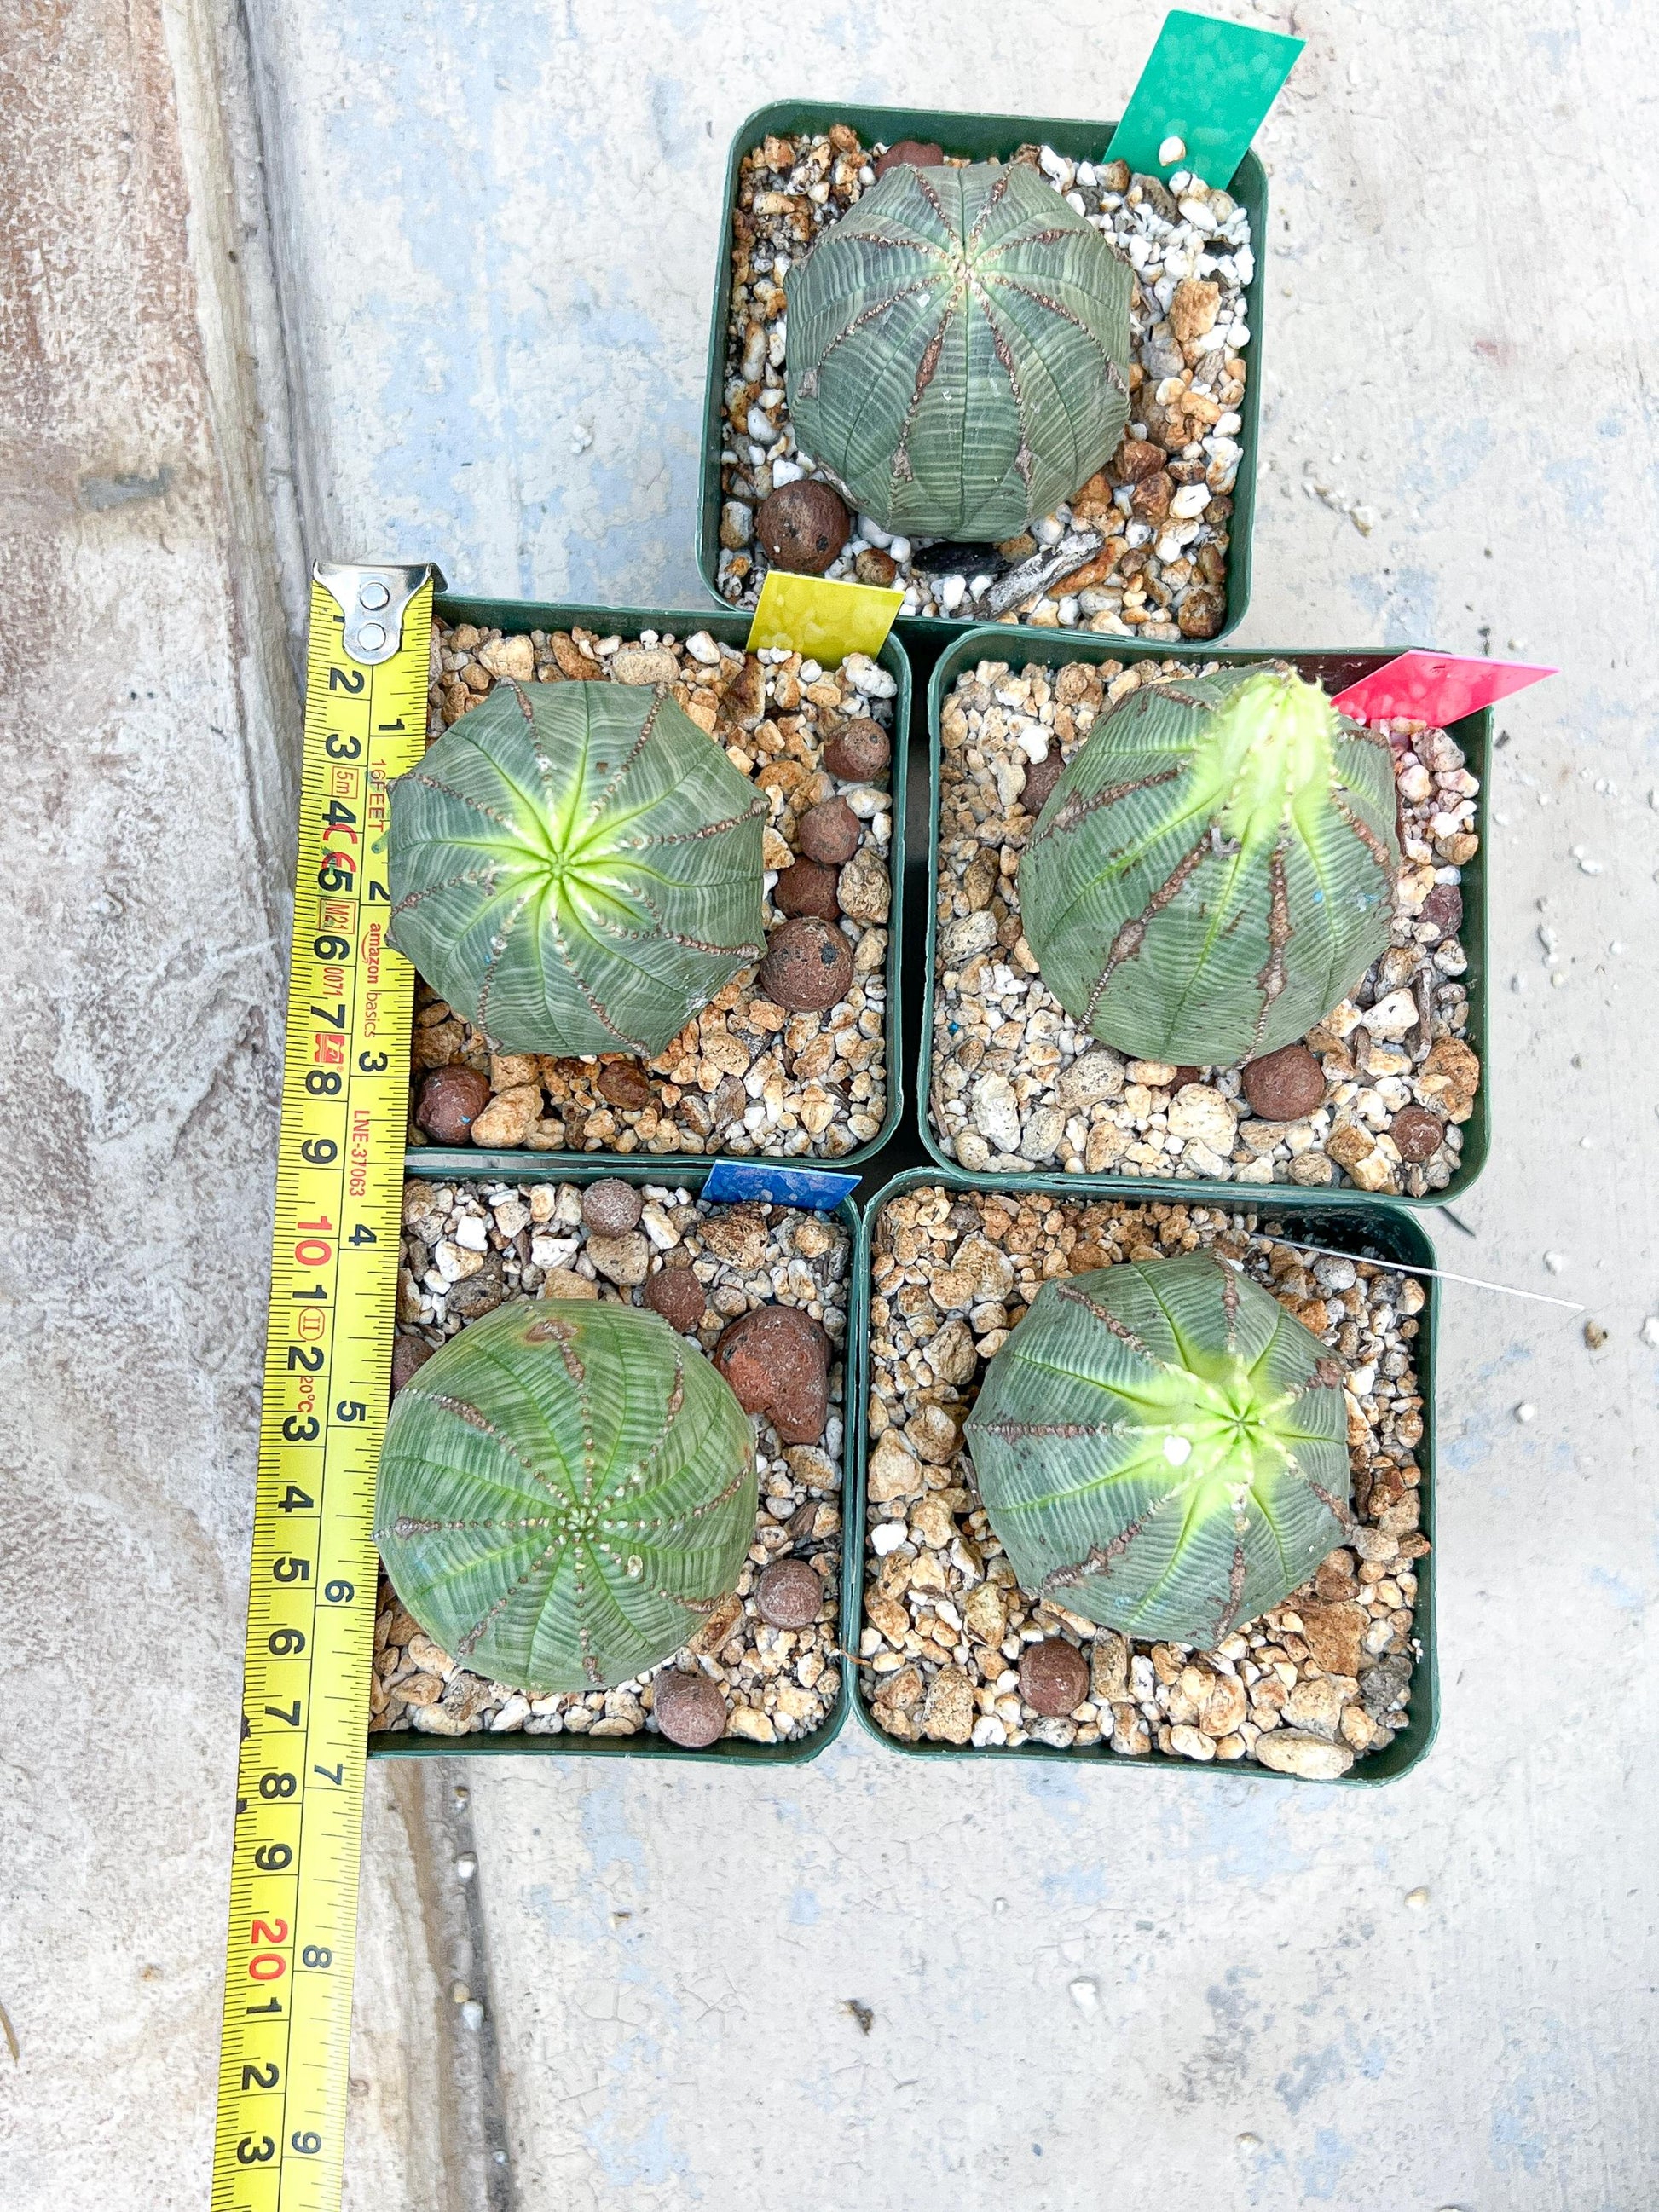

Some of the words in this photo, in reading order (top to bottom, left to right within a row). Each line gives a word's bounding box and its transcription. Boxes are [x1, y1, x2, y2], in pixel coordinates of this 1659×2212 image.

[329, 667, 365, 695] 2
[378, 718, 405, 731] 1
[325, 733, 361, 759] 3
[336, 771, 354, 794] 5m
[321, 800, 356, 824] 4
[318, 868, 353, 892] 5
[314, 935, 350, 960] 6
[367, 922, 381, 984] amazon
[323, 967, 344, 996] 0071
[310, 1003, 346, 1029] 7
[364, 991, 382, 1038] basics
[358, 1051, 388, 1072] 3
[305, 1070, 342, 1095] 8
[301, 1138, 338, 1164] 9
[349, 1110, 371, 1197] LNE-37063
[294, 1216, 332, 1266] 10
[348, 1224, 377, 1246] 4
[292, 1285, 327, 1299] 1
[287, 1345, 324, 1372] 2
[336, 1400, 366, 1422] 5
[282, 1415, 320, 1441] 3
[278, 1485, 314, 1513] 4
[273, 1556, 309, 1582] 5
[324, 1580, 355, 1603] 6
[268, 1628, 305, 1655] 6
[264, 1700, 301, 1726] 7
[258, 1772, 296, 1799] 8
[314, 1763, 343, 1786] 7
[254, 1843, 292, 1870] 9
[248, 1918, 288, 1980] 20
[302, 1944, 332, 1968] 8
[246, 1996, 282, 2014] 1
[241, 2062, 280, 2090] 2
[236, 2135, 275, 2164] 3
[291, 2130, 321, 2154] 9
